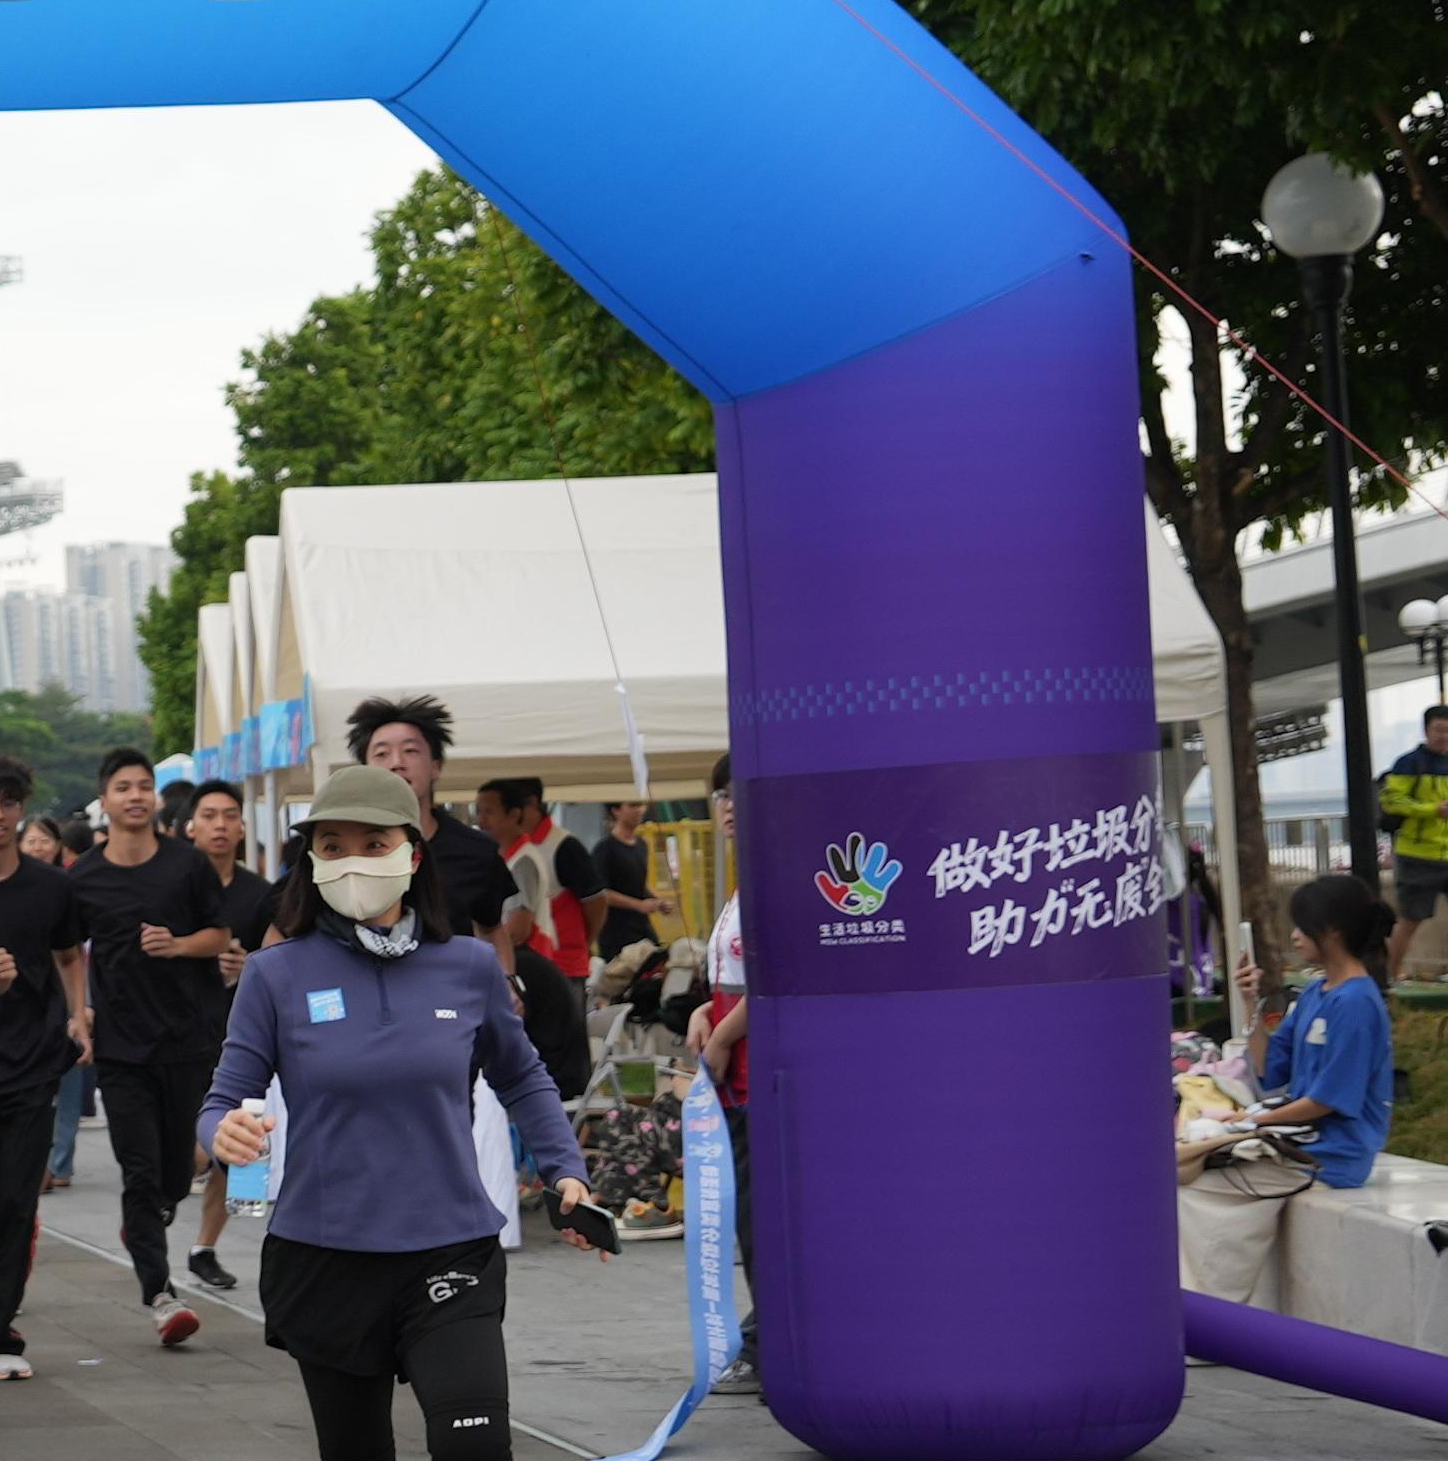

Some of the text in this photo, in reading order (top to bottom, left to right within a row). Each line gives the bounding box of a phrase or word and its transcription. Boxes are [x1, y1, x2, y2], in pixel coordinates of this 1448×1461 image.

[926, 791, 1164, 899] 做好垃圾分
